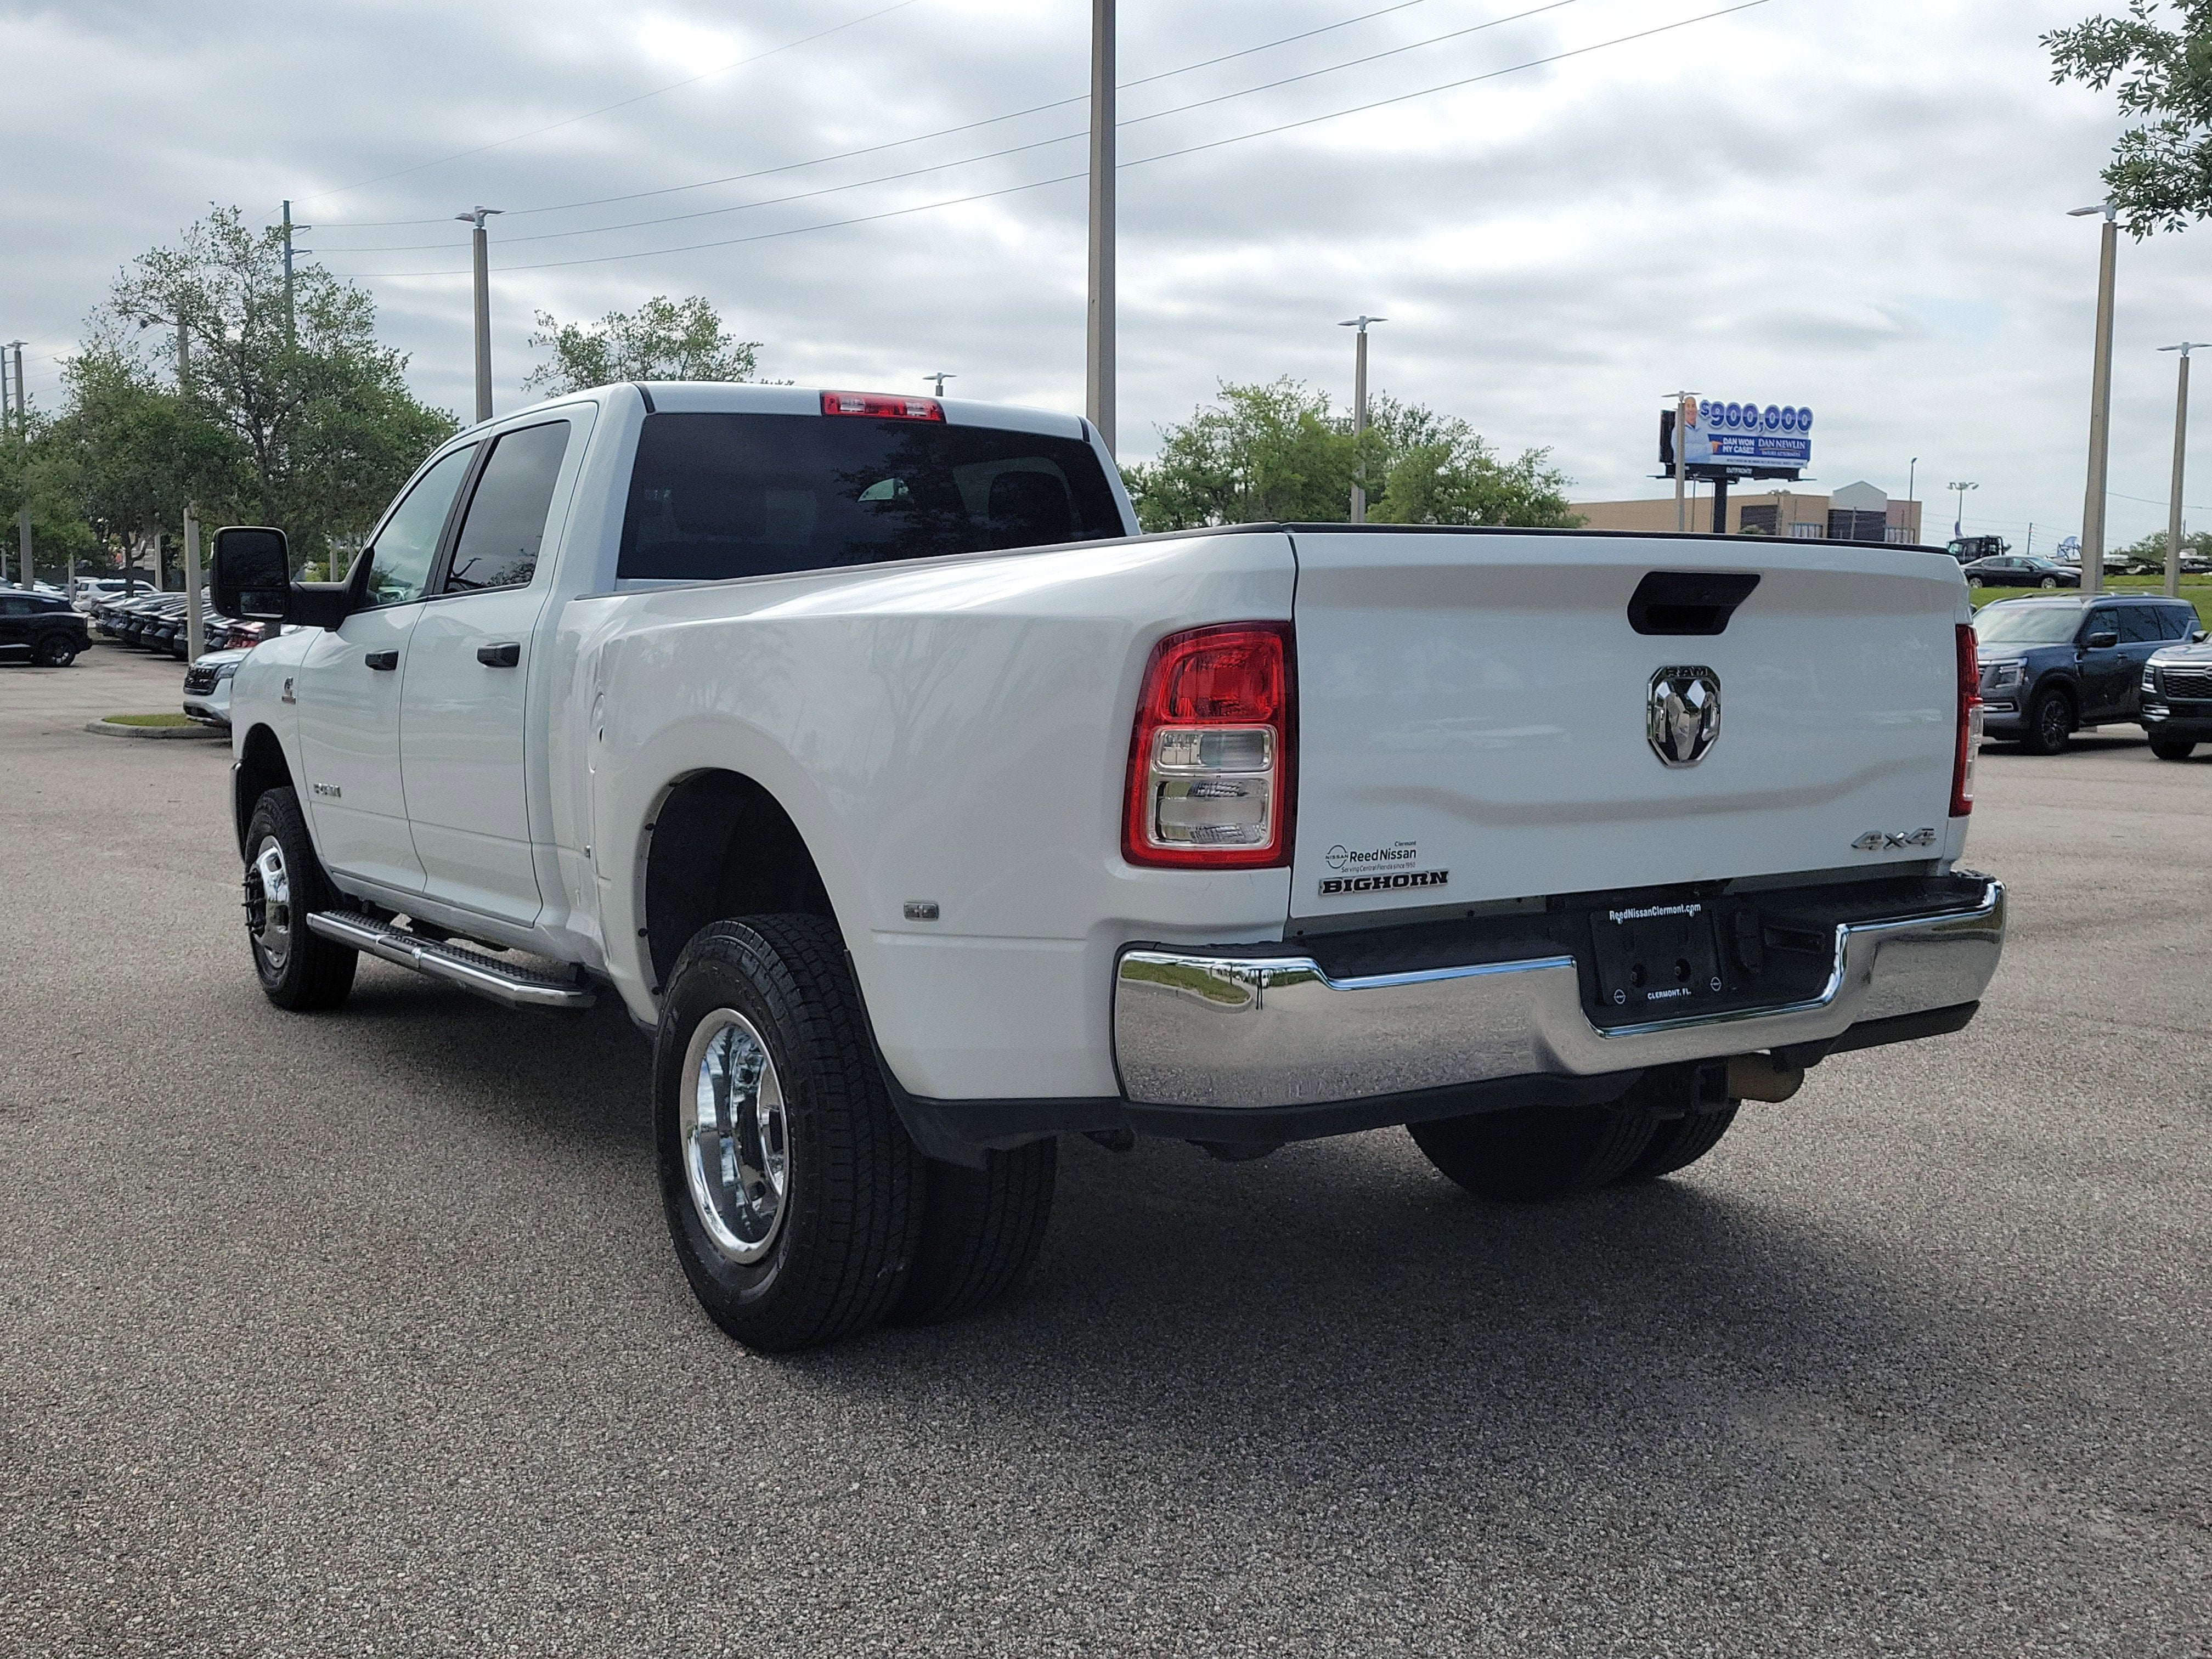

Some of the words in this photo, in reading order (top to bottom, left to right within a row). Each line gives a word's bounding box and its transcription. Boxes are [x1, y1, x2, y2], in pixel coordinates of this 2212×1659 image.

[1700, 400, 1813, 435] $900,000
[1738, 438, 1754, 446] WON
[1758, 438, 1775, 447] DAN
[1775, 439, 1805, 449] NEWLIN
[1666, 666, 1707, 677] RAM
[1350, 849, 1378, 862] Reed
[1380, 848, 1416, 861] Nissan
[1322, 870, 1449, 894] BIGHORN
[1609, 903, 1701, 921] ReedNissanClermont.com
